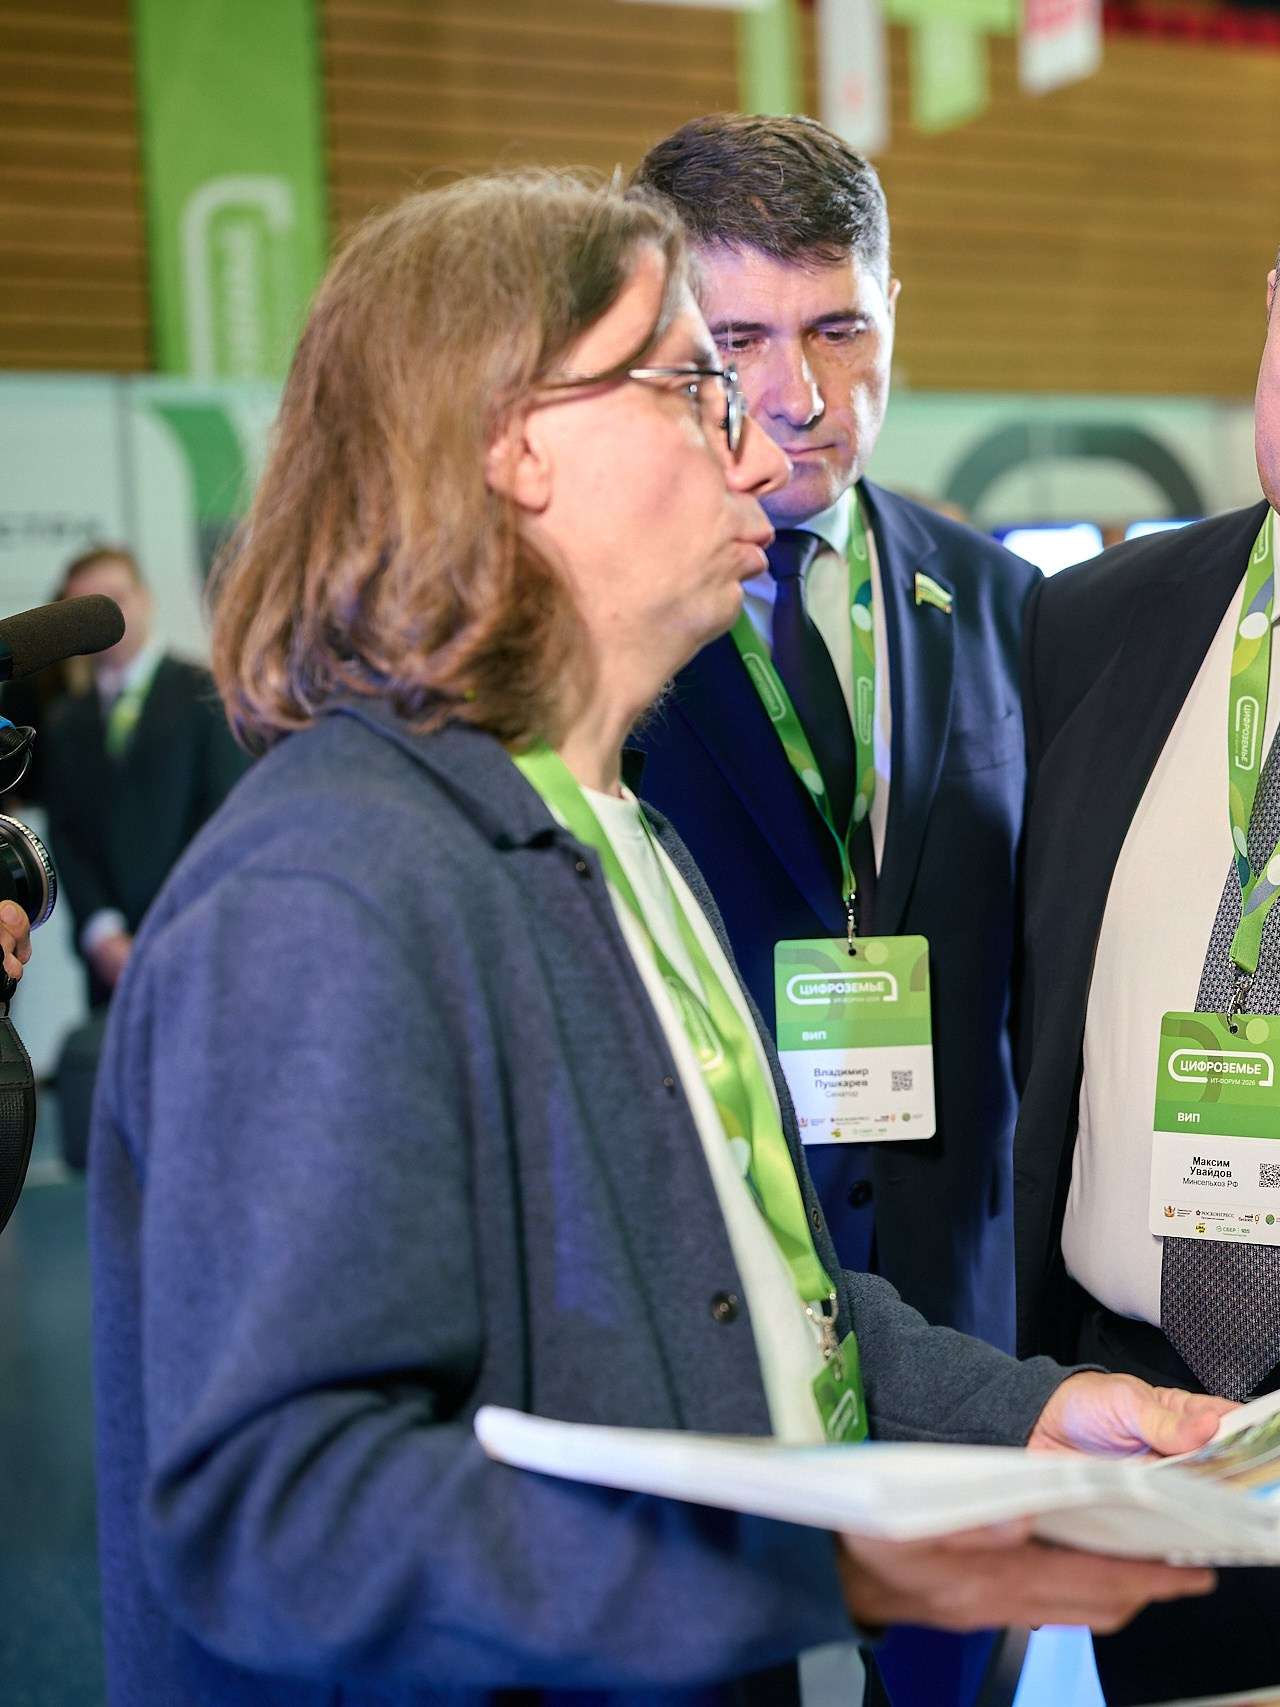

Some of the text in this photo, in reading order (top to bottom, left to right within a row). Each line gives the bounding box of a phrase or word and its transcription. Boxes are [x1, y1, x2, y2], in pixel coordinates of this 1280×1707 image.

[1242, 704, 1253, 762] ЦИФРОЗЕМЬЕ
[799, 981, 885, 996] ЦИФРОЗЕМЬЕ
[802, 1031, 827, 1041] ВИП
[814, 1068, 869, 1077] Владимир
[1180, 1060, 1262, 1075] ЦИФРОЗЕМЬЕ
[1210, 1078, 1241, 1086] ИТ-ФОРУМ
[1177, 1112, 1201, 1123] ВИП
[1192, 1156, 1231, 1168] Максим
[1189, 1166, 1232, 1179] Увайдов
[1182, 1177, 1239, 1188] Минсельхоз РФ
